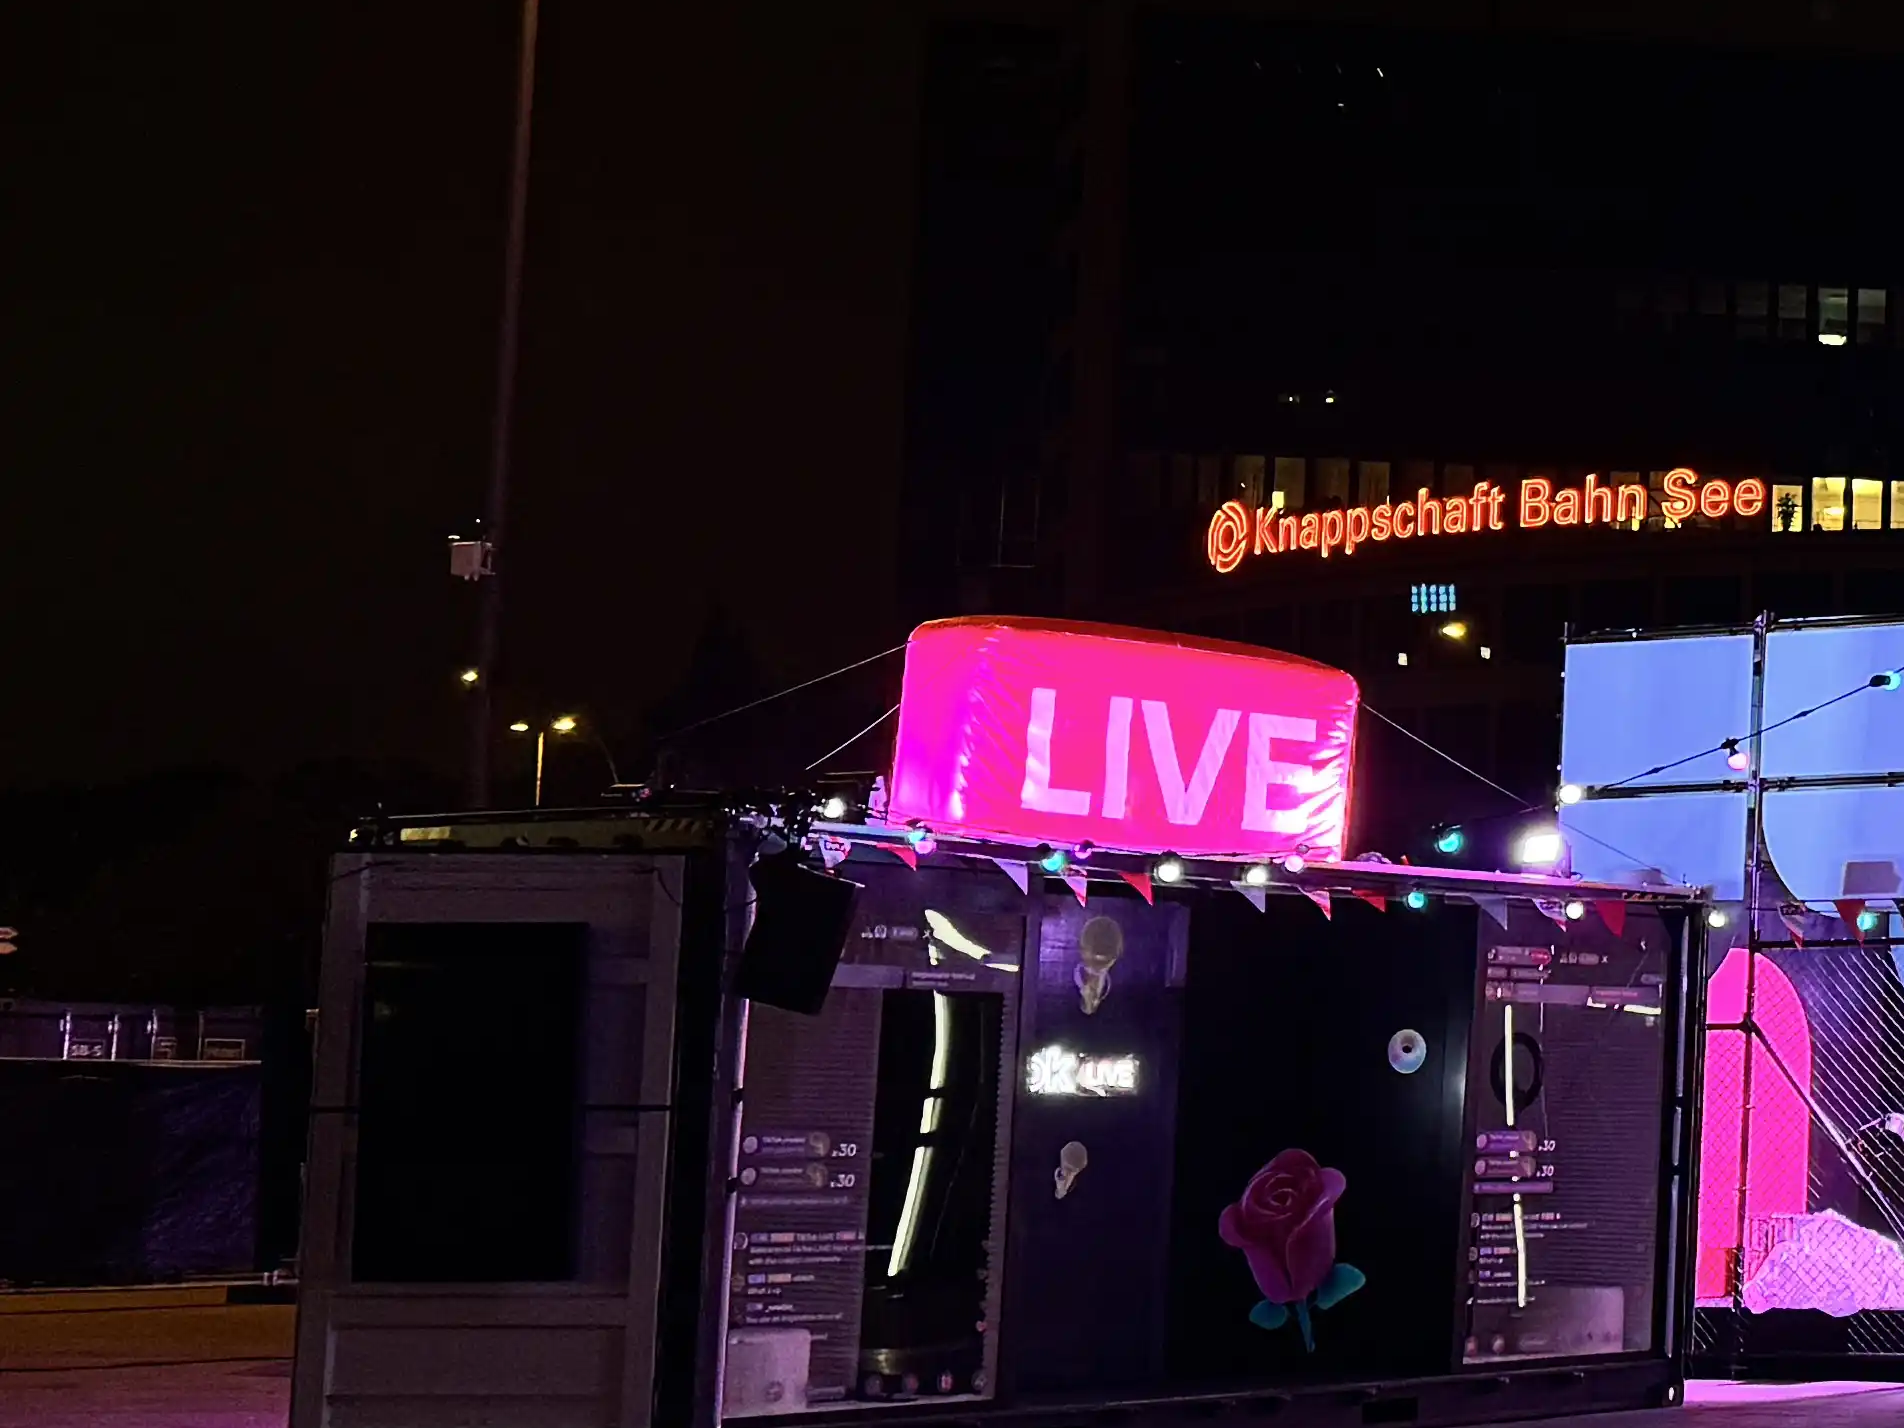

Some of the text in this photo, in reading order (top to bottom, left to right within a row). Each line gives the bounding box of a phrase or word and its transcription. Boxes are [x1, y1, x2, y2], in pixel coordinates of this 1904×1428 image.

[1254, 467, 1765, 559] Knappschaft Bahn See
[1020, 687, 1318, 835] LIVE
